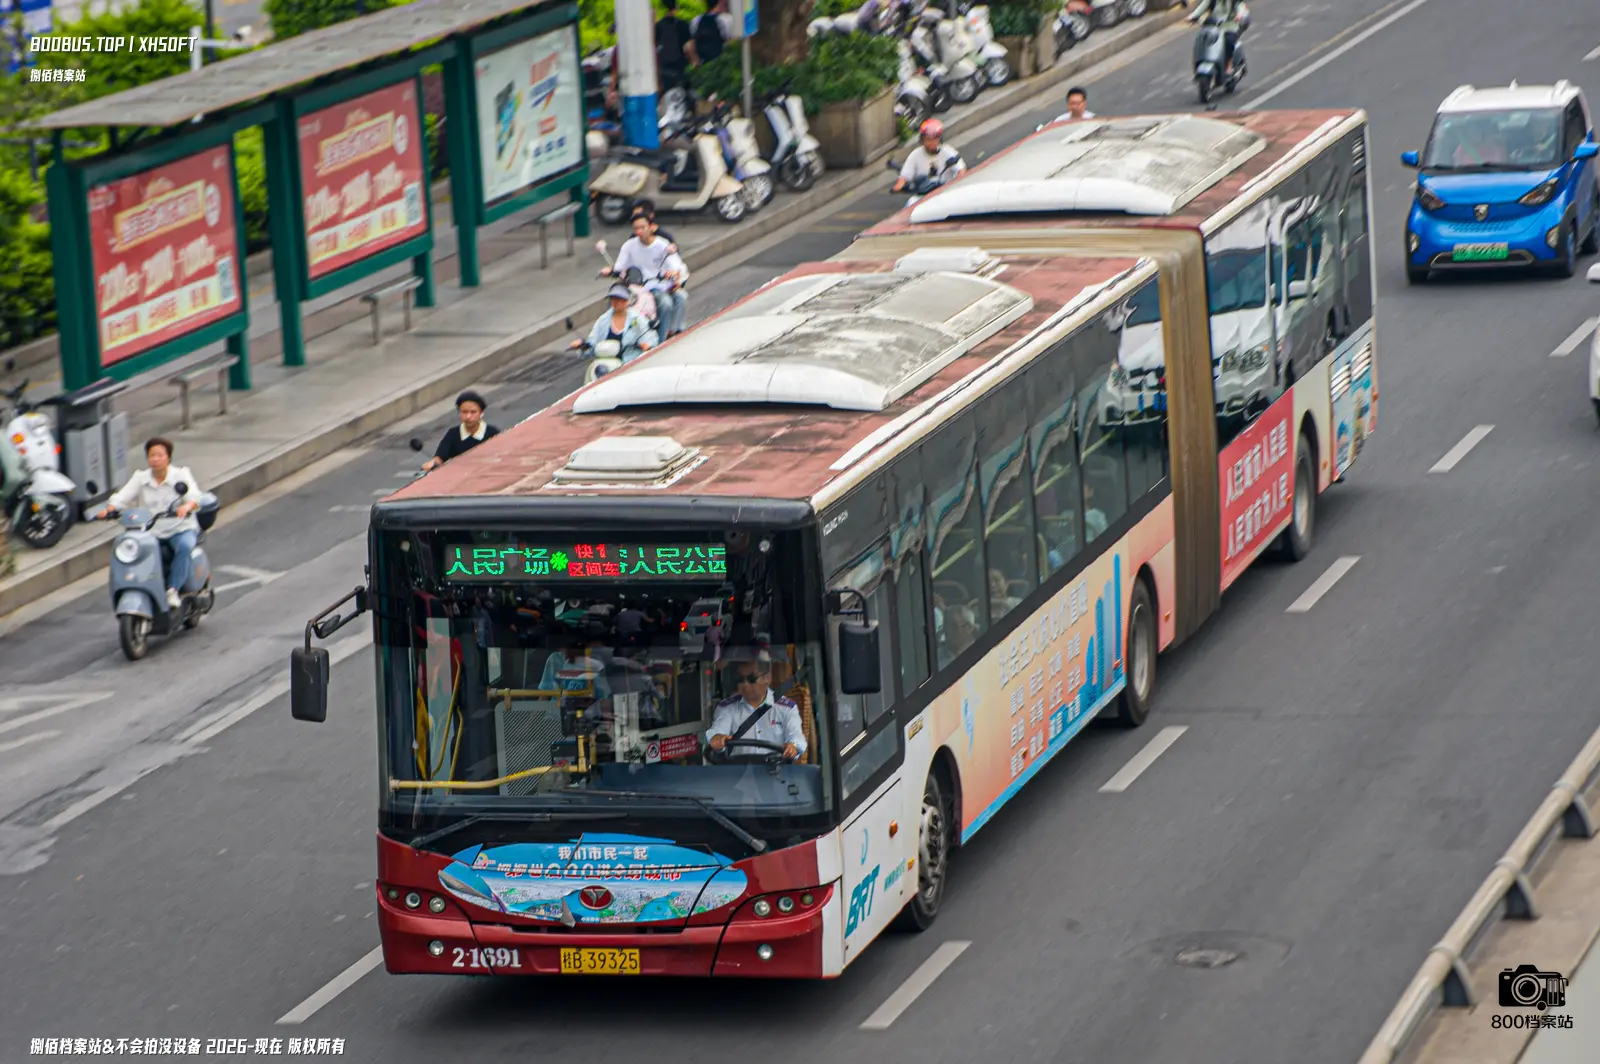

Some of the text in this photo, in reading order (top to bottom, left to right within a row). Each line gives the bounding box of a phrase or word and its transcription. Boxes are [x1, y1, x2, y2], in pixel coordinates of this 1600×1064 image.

[446, 547, 550, 576] 人民广场
[568, 562, 620, 577] 区间车
[558, 846, 649, 861] 我们市民一起
[844, 863, 881, 939] BRT
